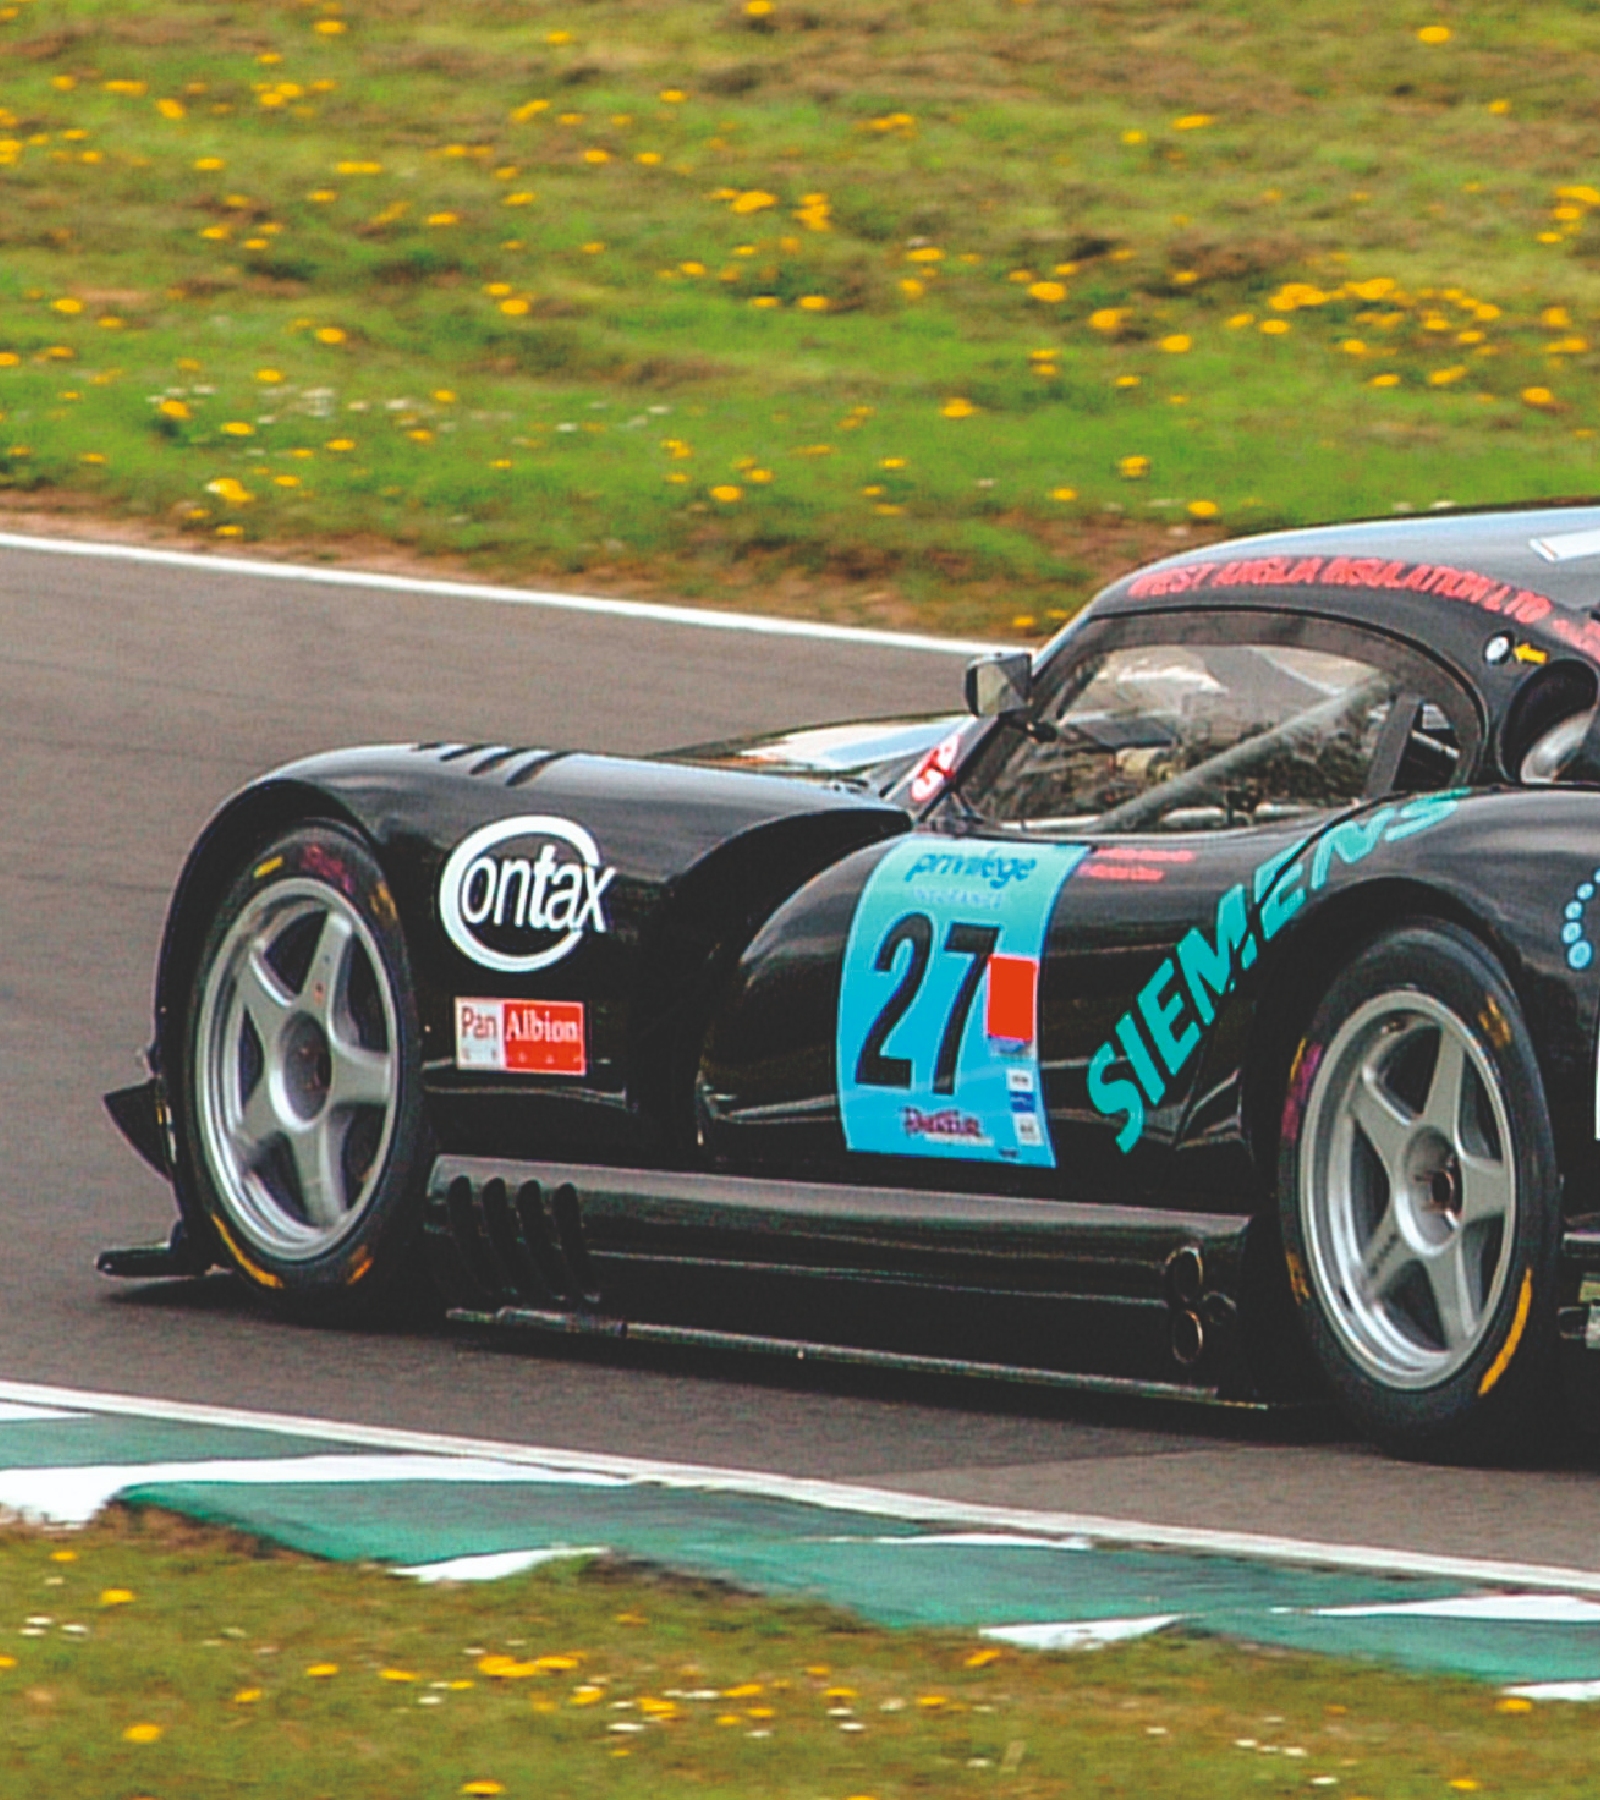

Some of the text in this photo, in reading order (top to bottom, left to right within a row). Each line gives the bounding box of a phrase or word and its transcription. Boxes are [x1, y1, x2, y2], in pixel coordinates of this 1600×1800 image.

[461, 1005, 579, 1043] Pan Albion
[855, 911, 1001, 1095] 27
[1086, 786, 1472, 1152] SIEMENS
